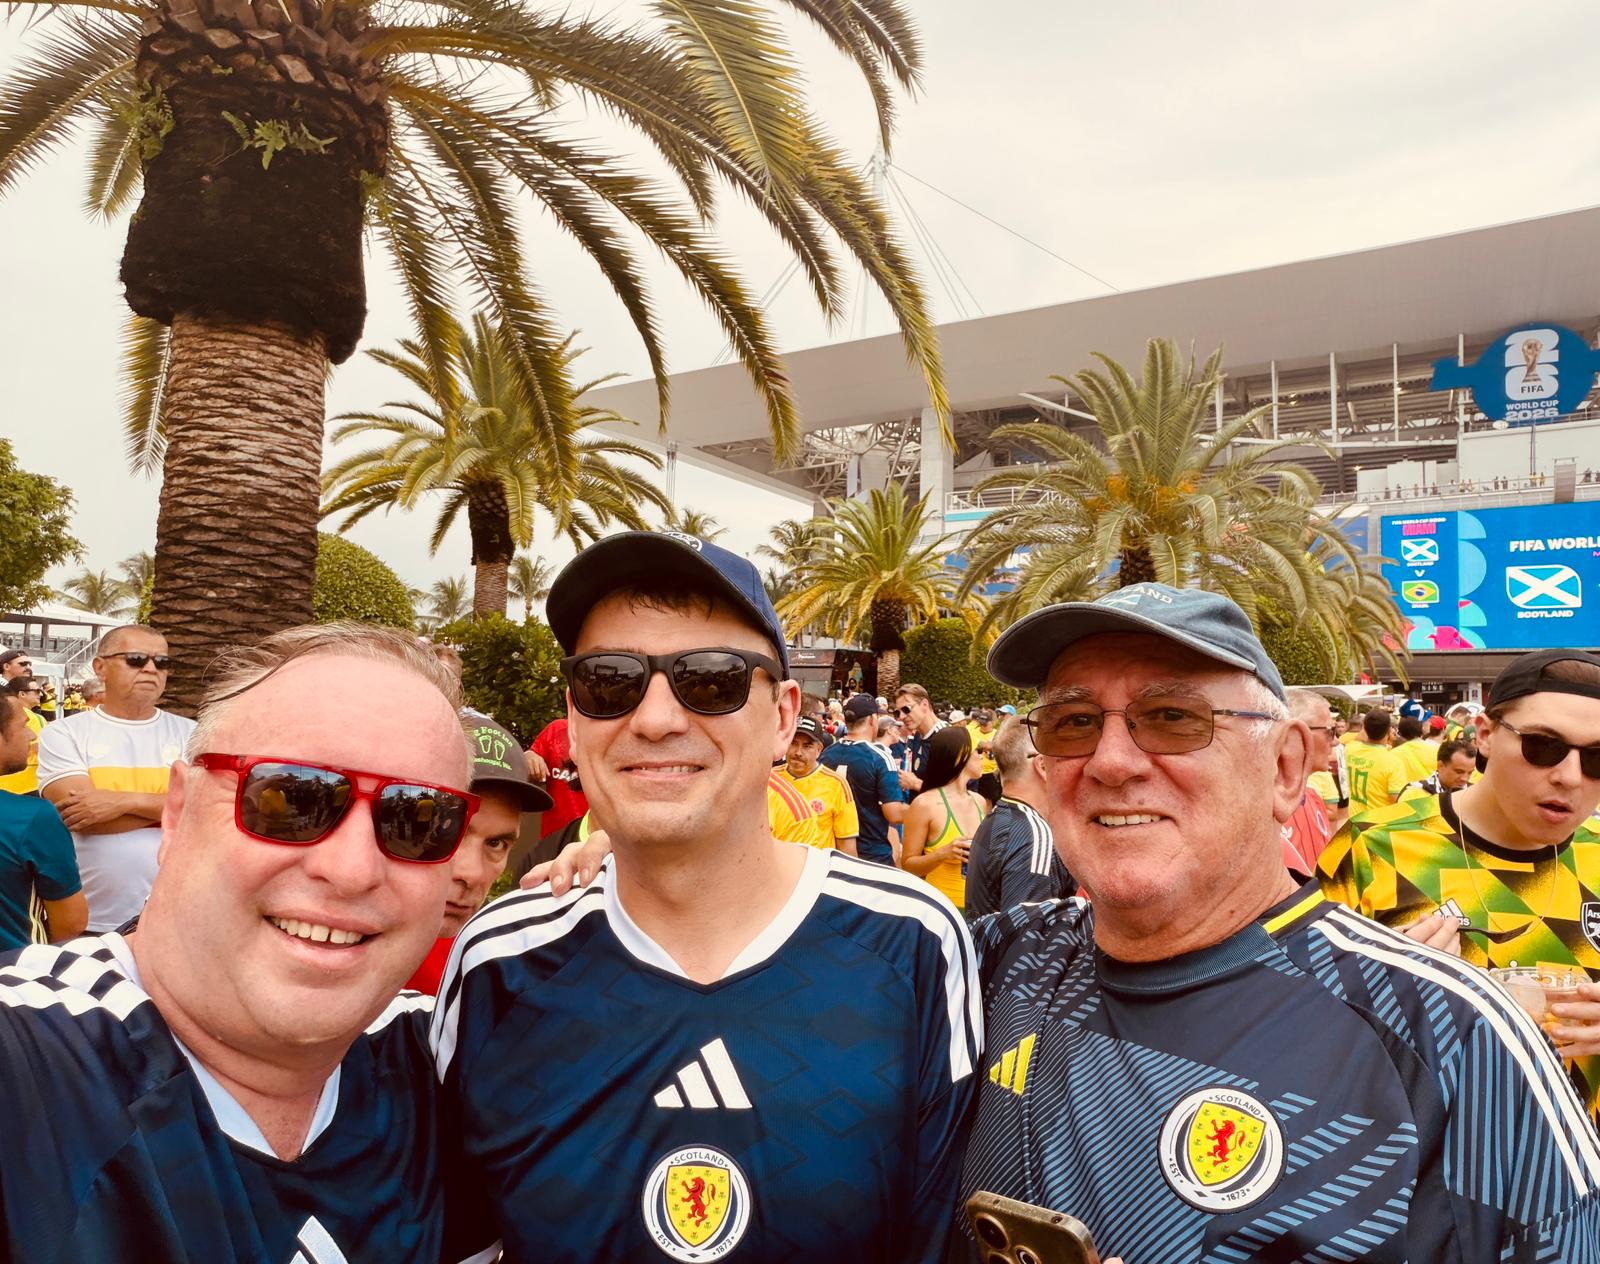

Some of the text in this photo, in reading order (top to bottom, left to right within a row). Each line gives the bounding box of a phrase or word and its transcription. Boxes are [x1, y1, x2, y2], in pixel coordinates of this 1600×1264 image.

[1520, 384, 1544, 394] FIFA
[1506, 399, 1559, 411] WORLD CUP
[1505, 409, 1559, 421] 2026
[1509, 536, 1600, 553] FIFA WORL
[1517, 610, 1574, 619] SCOTLAND
[1215, 1094, 1261, 1116] SCOTLAND
[674, 1151, 725, 1166] SCOTLAND
[1169, 1163, 1248, 1202] EST 1873
[657, 1234, 733, 1255] EST 1873
